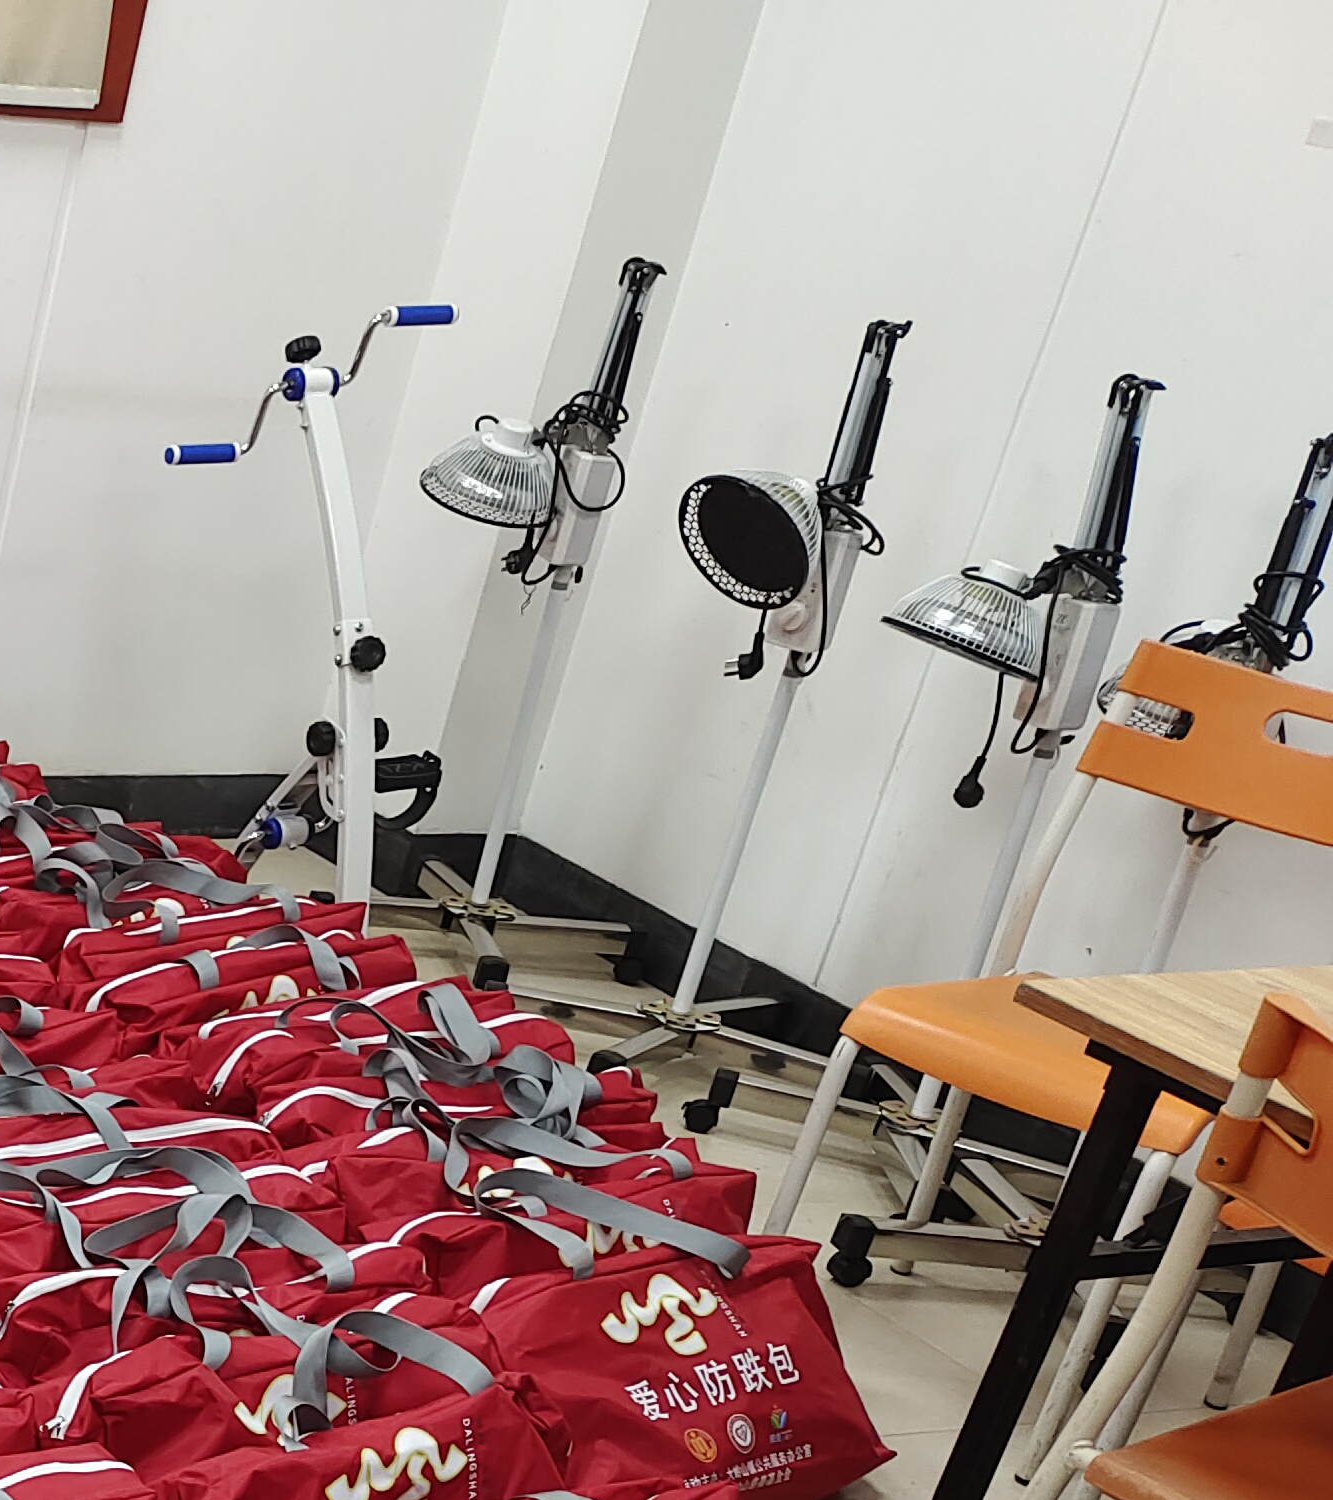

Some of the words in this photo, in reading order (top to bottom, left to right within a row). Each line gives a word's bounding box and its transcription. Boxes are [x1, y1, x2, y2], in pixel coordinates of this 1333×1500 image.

[624, 1342, 801, 1422] 爱心防跌包
